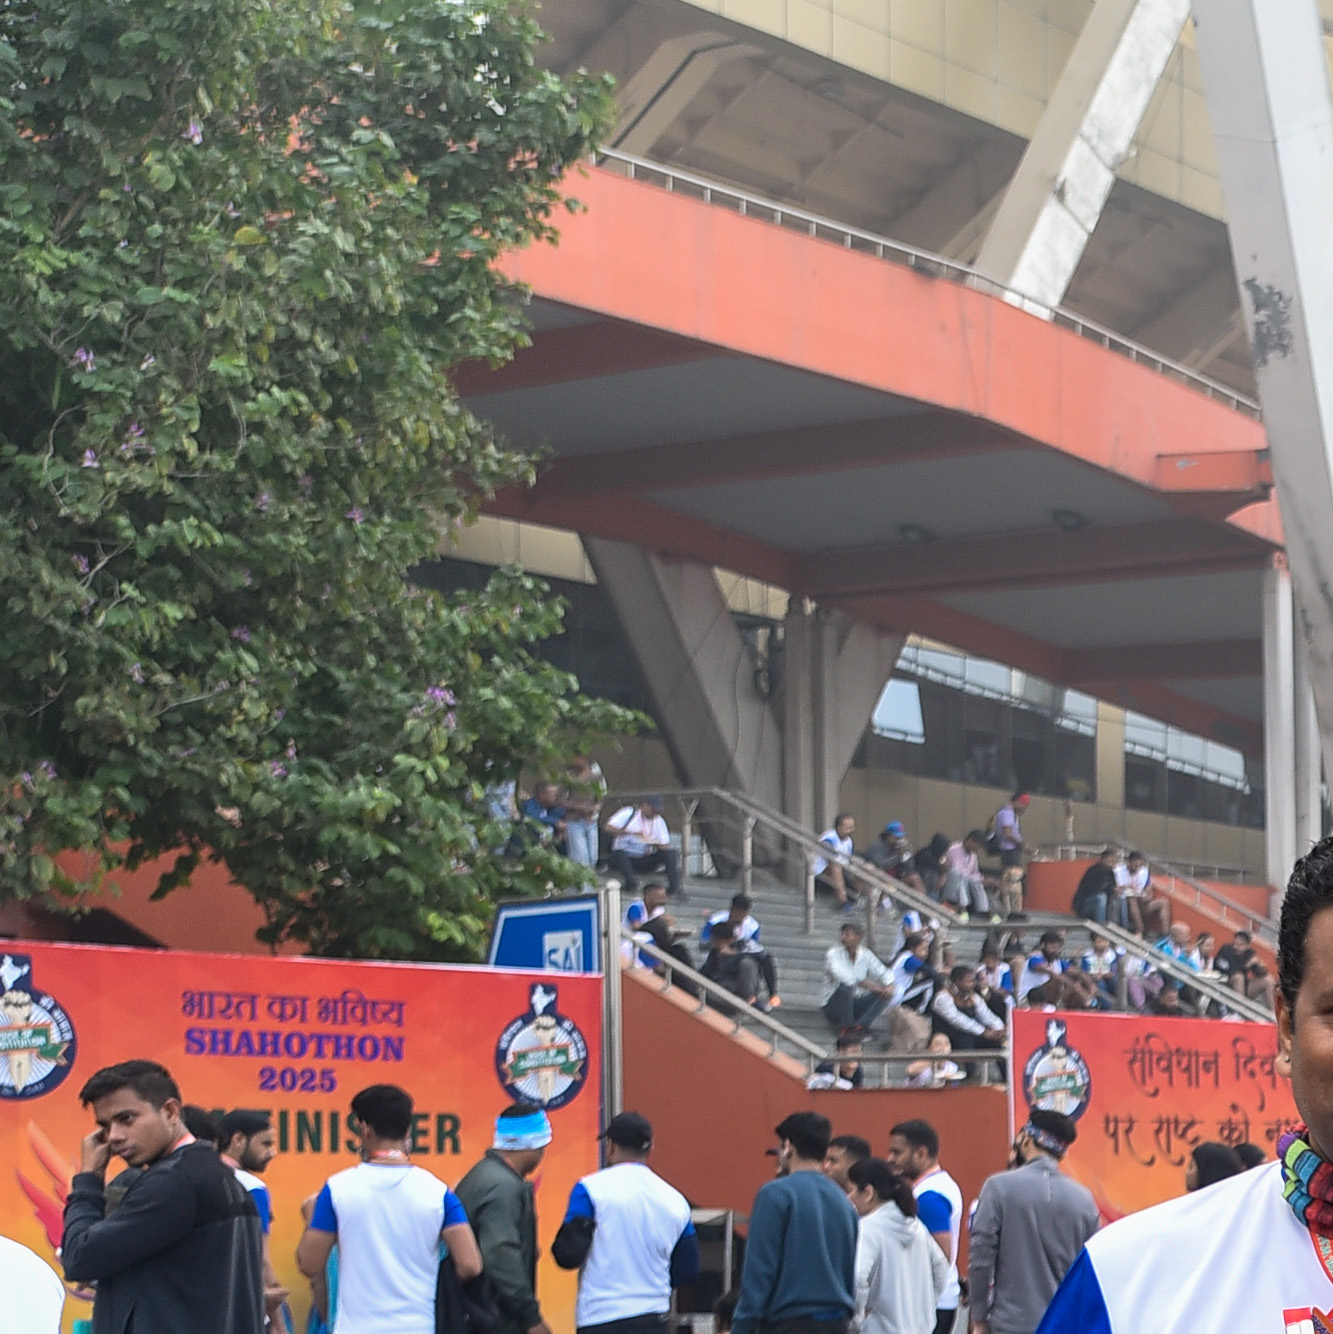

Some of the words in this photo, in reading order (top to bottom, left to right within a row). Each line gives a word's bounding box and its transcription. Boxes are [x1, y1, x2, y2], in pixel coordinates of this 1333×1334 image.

[181, 989, 258, 1021] भारत
[266, 995, 308, 1023] का
[317, 989, 405, 1027] भविष्य
[184, 1027, 405, 1062] SHAHOTHON
[259, 1066, 337, 1093] 2025
[1231, 1036, 1287, 1111] दिव
[264, 1107, 461, 1155] INISER
[1103, 1112, 1156, 1166] पर
